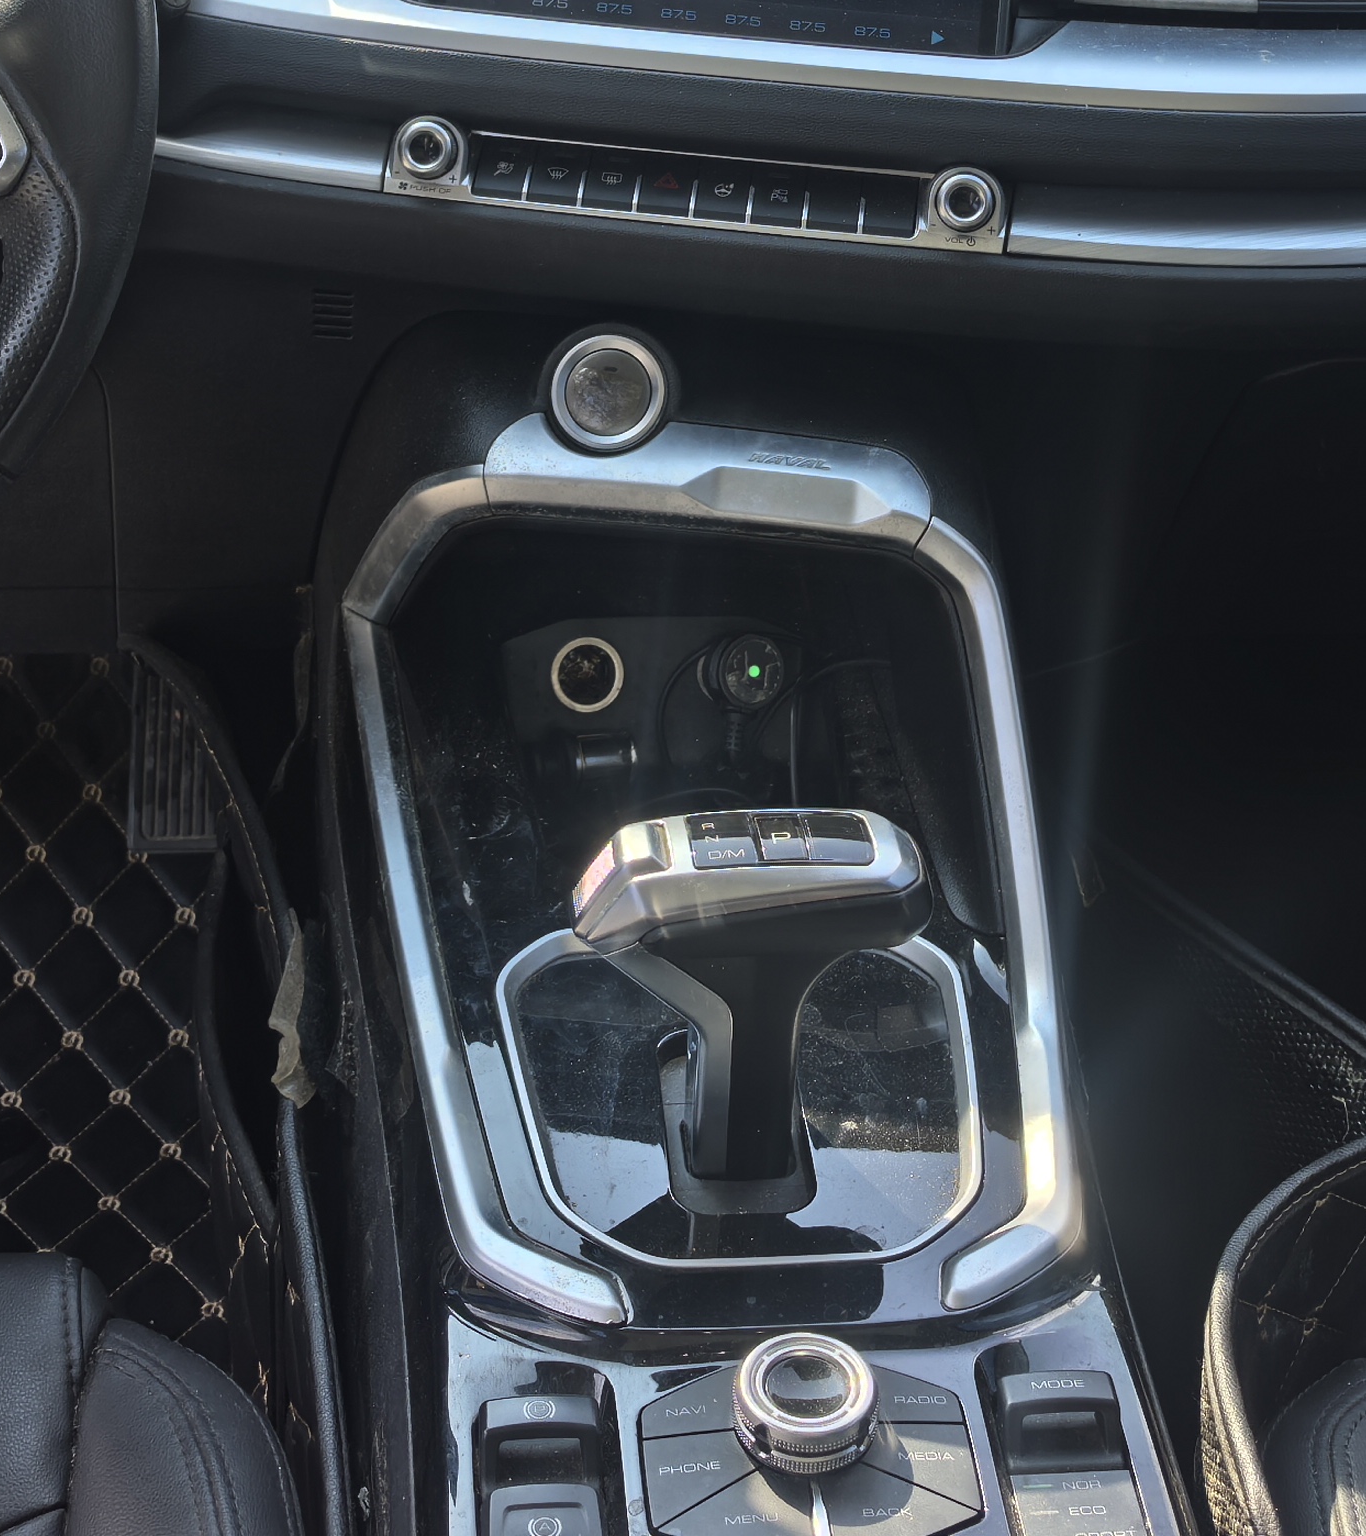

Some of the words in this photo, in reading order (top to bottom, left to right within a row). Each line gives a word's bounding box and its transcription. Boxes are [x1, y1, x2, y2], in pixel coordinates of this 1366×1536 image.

[596, 2, 633, 15] 87.5
[660, 8, 697, 21] 87.5
[725, 14, 762, 27] 87.5
[789, 20, 826, 33] 87.5
[854, 26, 891, 39] 87.5
[944, 236, 964, 244] VOL
[748, 452, 831, 471] HAVAL
[705, 835, 719, 843] N
[771, 832, 791, 844] P
[708, 848, 745, 860] D/M
[1030, 1379, 1086, 1390] MODE
[894, 1395, 948, 1405] RADIO
[665, 1404, 706, 1418] NAVI
[897, 1451, 955, 1461] MEDIA
[659, 1460, 721, 1476] PHONE
[1062, 1480, 1102, 1491] NOR
[862, 1507, 913, 1518] BACK
[1068, 1505, 1107, 1516] ECO
[724, 1512, 779, 1526] MENU
